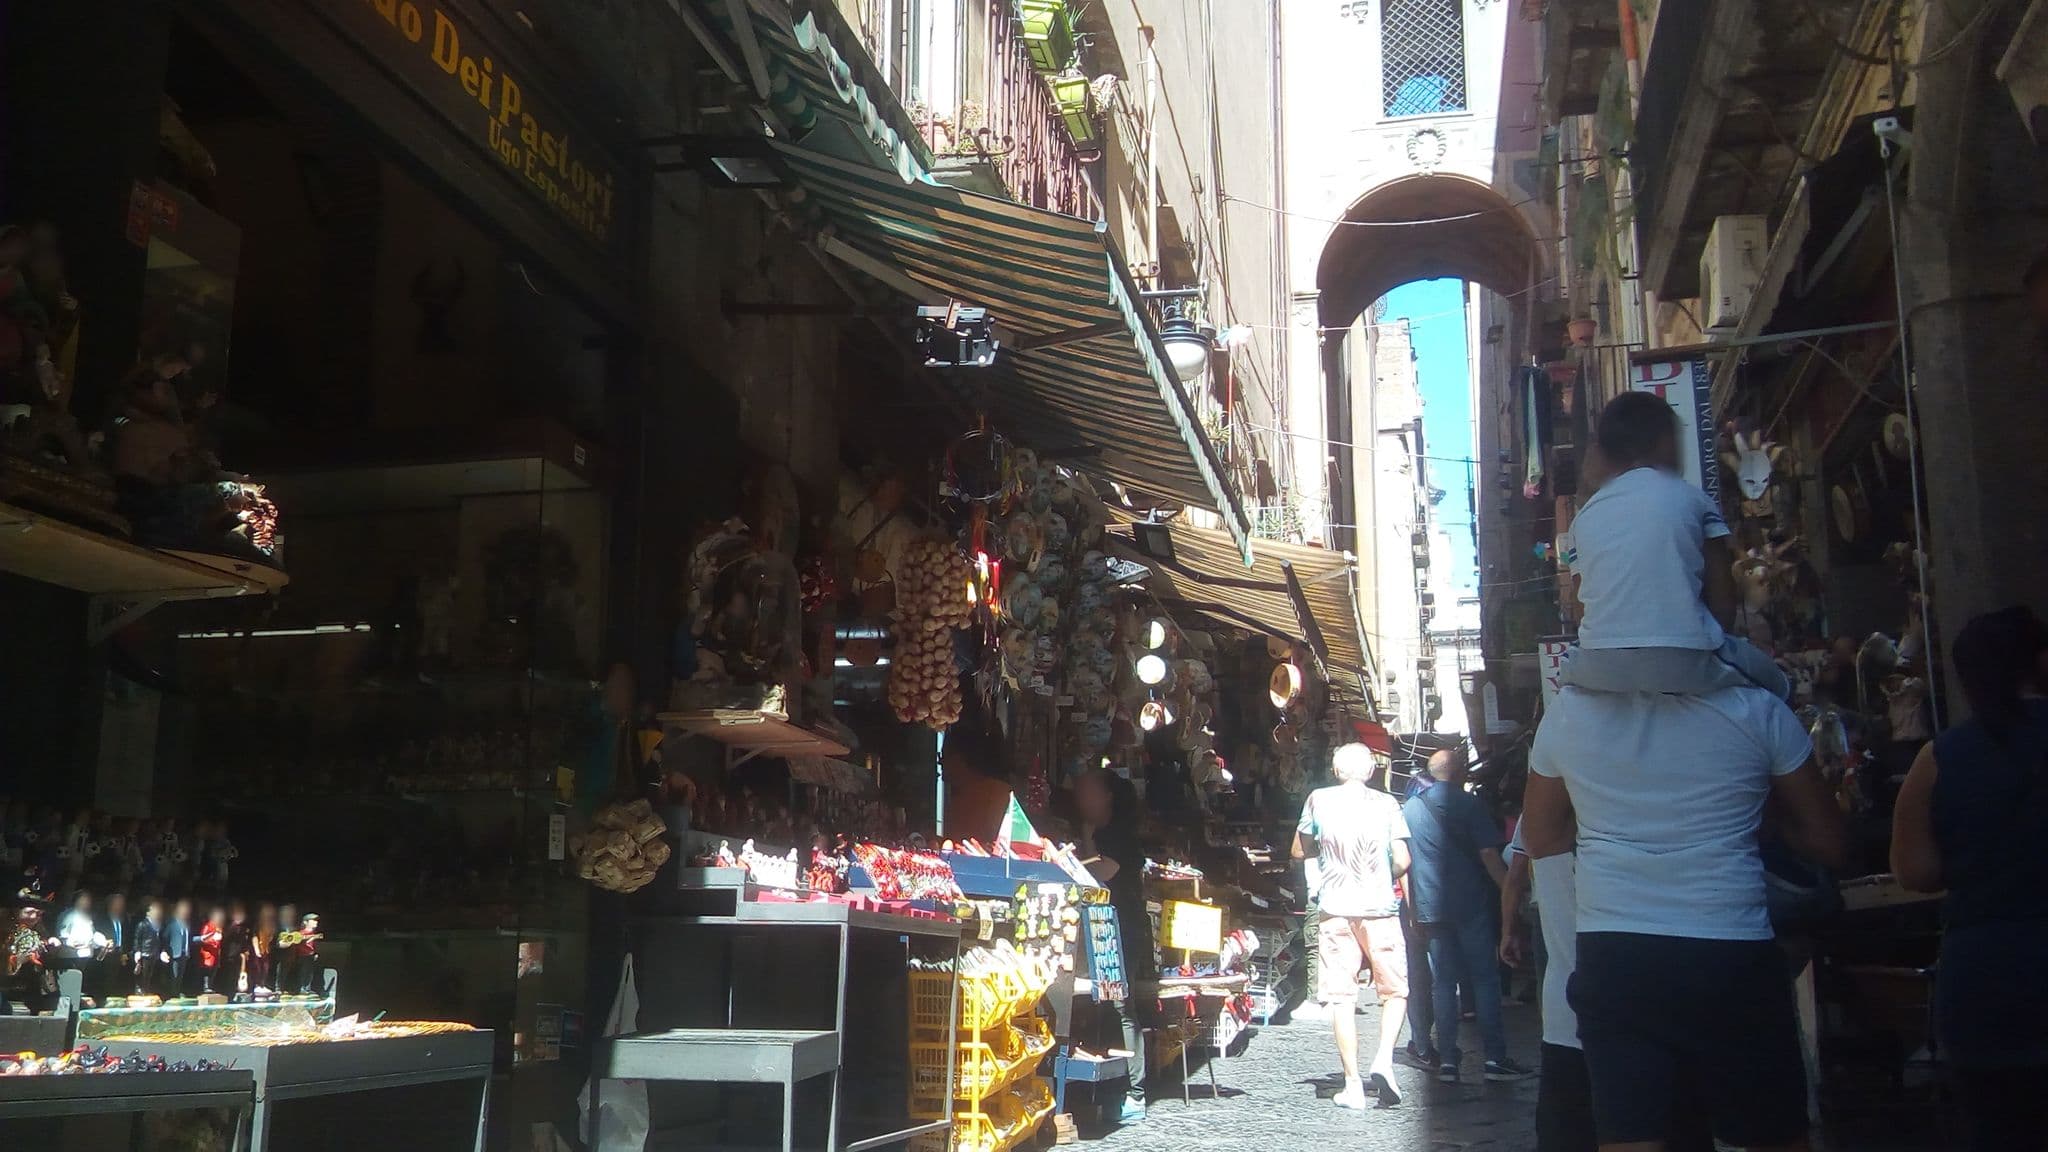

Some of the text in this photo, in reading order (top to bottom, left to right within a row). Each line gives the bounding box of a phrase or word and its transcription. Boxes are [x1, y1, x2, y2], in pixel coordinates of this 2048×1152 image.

[432, 8, 494, 111] Dei
[499, 72, 614, 222] Pastori
[488, 114, 521, 169] Ugo
